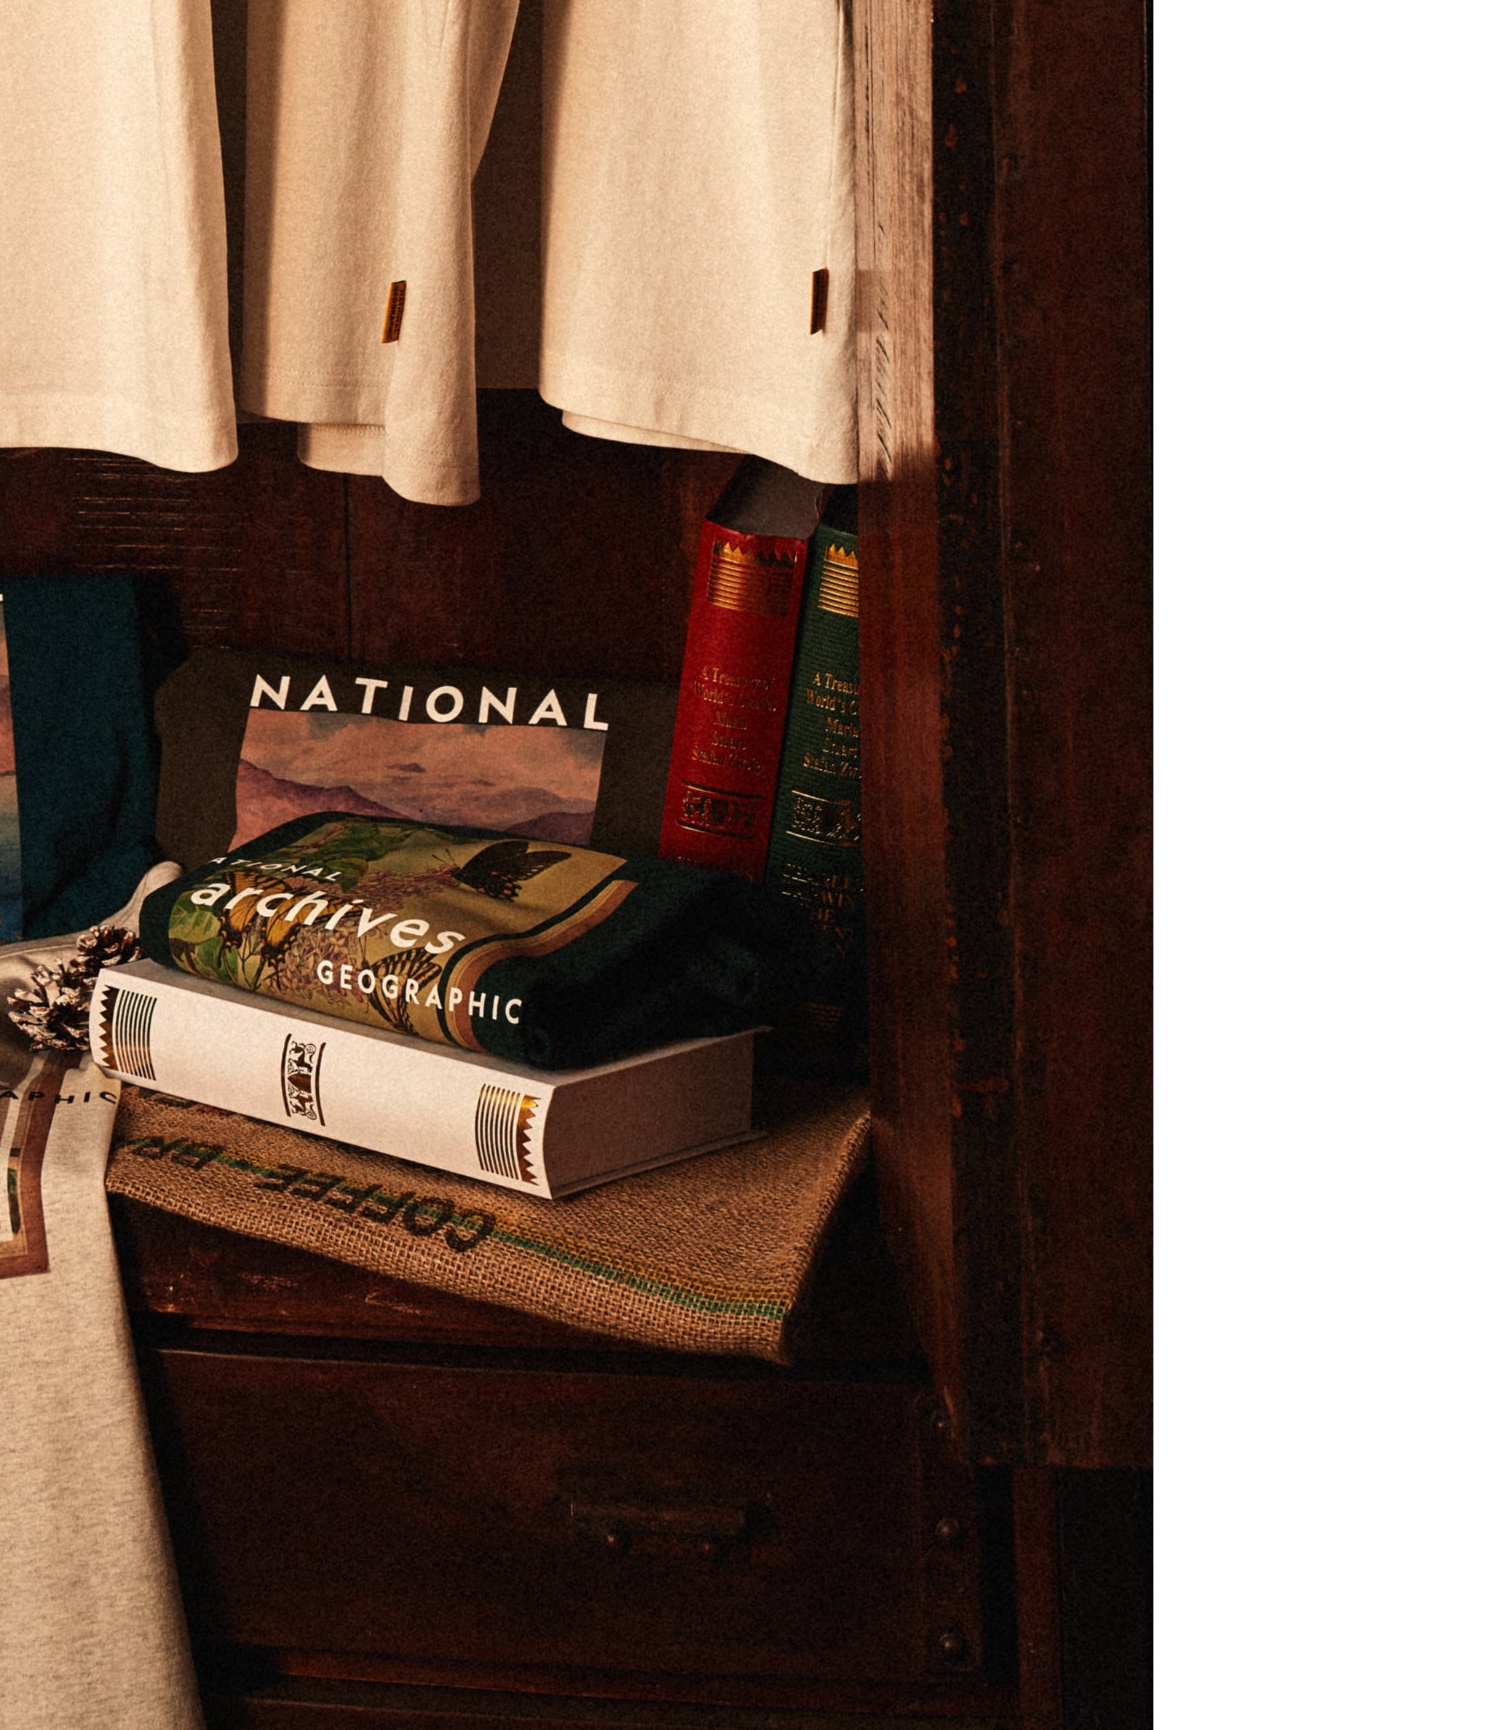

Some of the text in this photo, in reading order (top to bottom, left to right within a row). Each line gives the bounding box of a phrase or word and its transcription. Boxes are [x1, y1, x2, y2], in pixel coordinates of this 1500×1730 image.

[249, 673, 609, 731] NATIONAL
[812, 671, 860, 695] A Treasu
[207, 856, 343, 882] ATIONAL
[190, 882, 466, 954] archives
[316, 960, 523, 1025] GEOGRAPHIC
[254, 1162, 498, 1253] COFFEE
